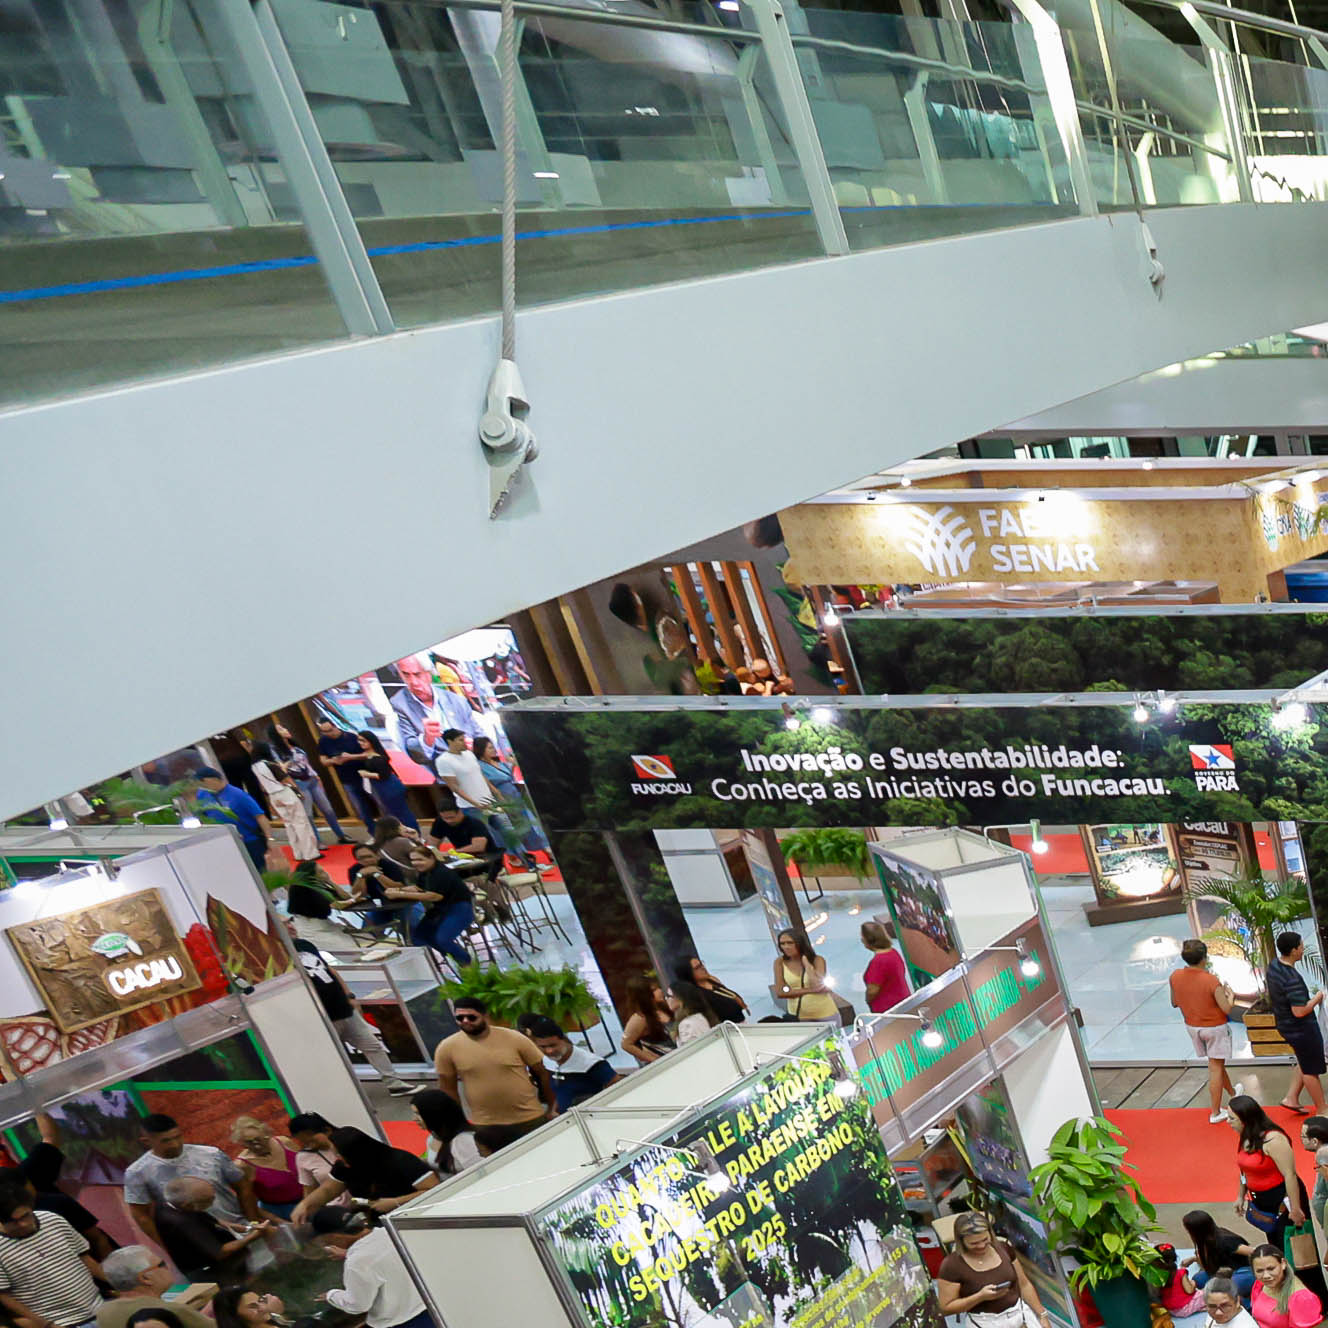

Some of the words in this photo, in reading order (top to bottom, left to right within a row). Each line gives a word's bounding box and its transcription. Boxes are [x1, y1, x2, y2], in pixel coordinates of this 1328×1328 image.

[990, 543, 1100, 572] SENAR
[741, 747, 863, 777] Inovação
[869, 753, 886, 771] e
[891, 745, 1125, 770] Sustentabilidade:
[631, 783, 692, 795] FUNCACAU
[711, 778, 827, 805] Conheça
[832, 781, 861, 798] as
[865, 776, 996, 799] Iniciativas
[1002, 775, 1036, 797] do
[1041, 774, 1172, 797] Funcacau.
[108, 955, 183, 996] CACAU
[590, 1152, 686, 1231] QUANTO
[734, 1106, 755, 1136] A
[750, 1055, 833, 1126] LAVOURA
[723, 1104, 820, 1187] PARAENSE
[815, 1086, 844, 1123] EM
[625, 1199, 748, 1303] SEQUESTRO
[744, 1178, 775, 1216] DE
[771, 1119, 855, 1196] CARBONO
[739, 1211, 787, 1263] 2025
